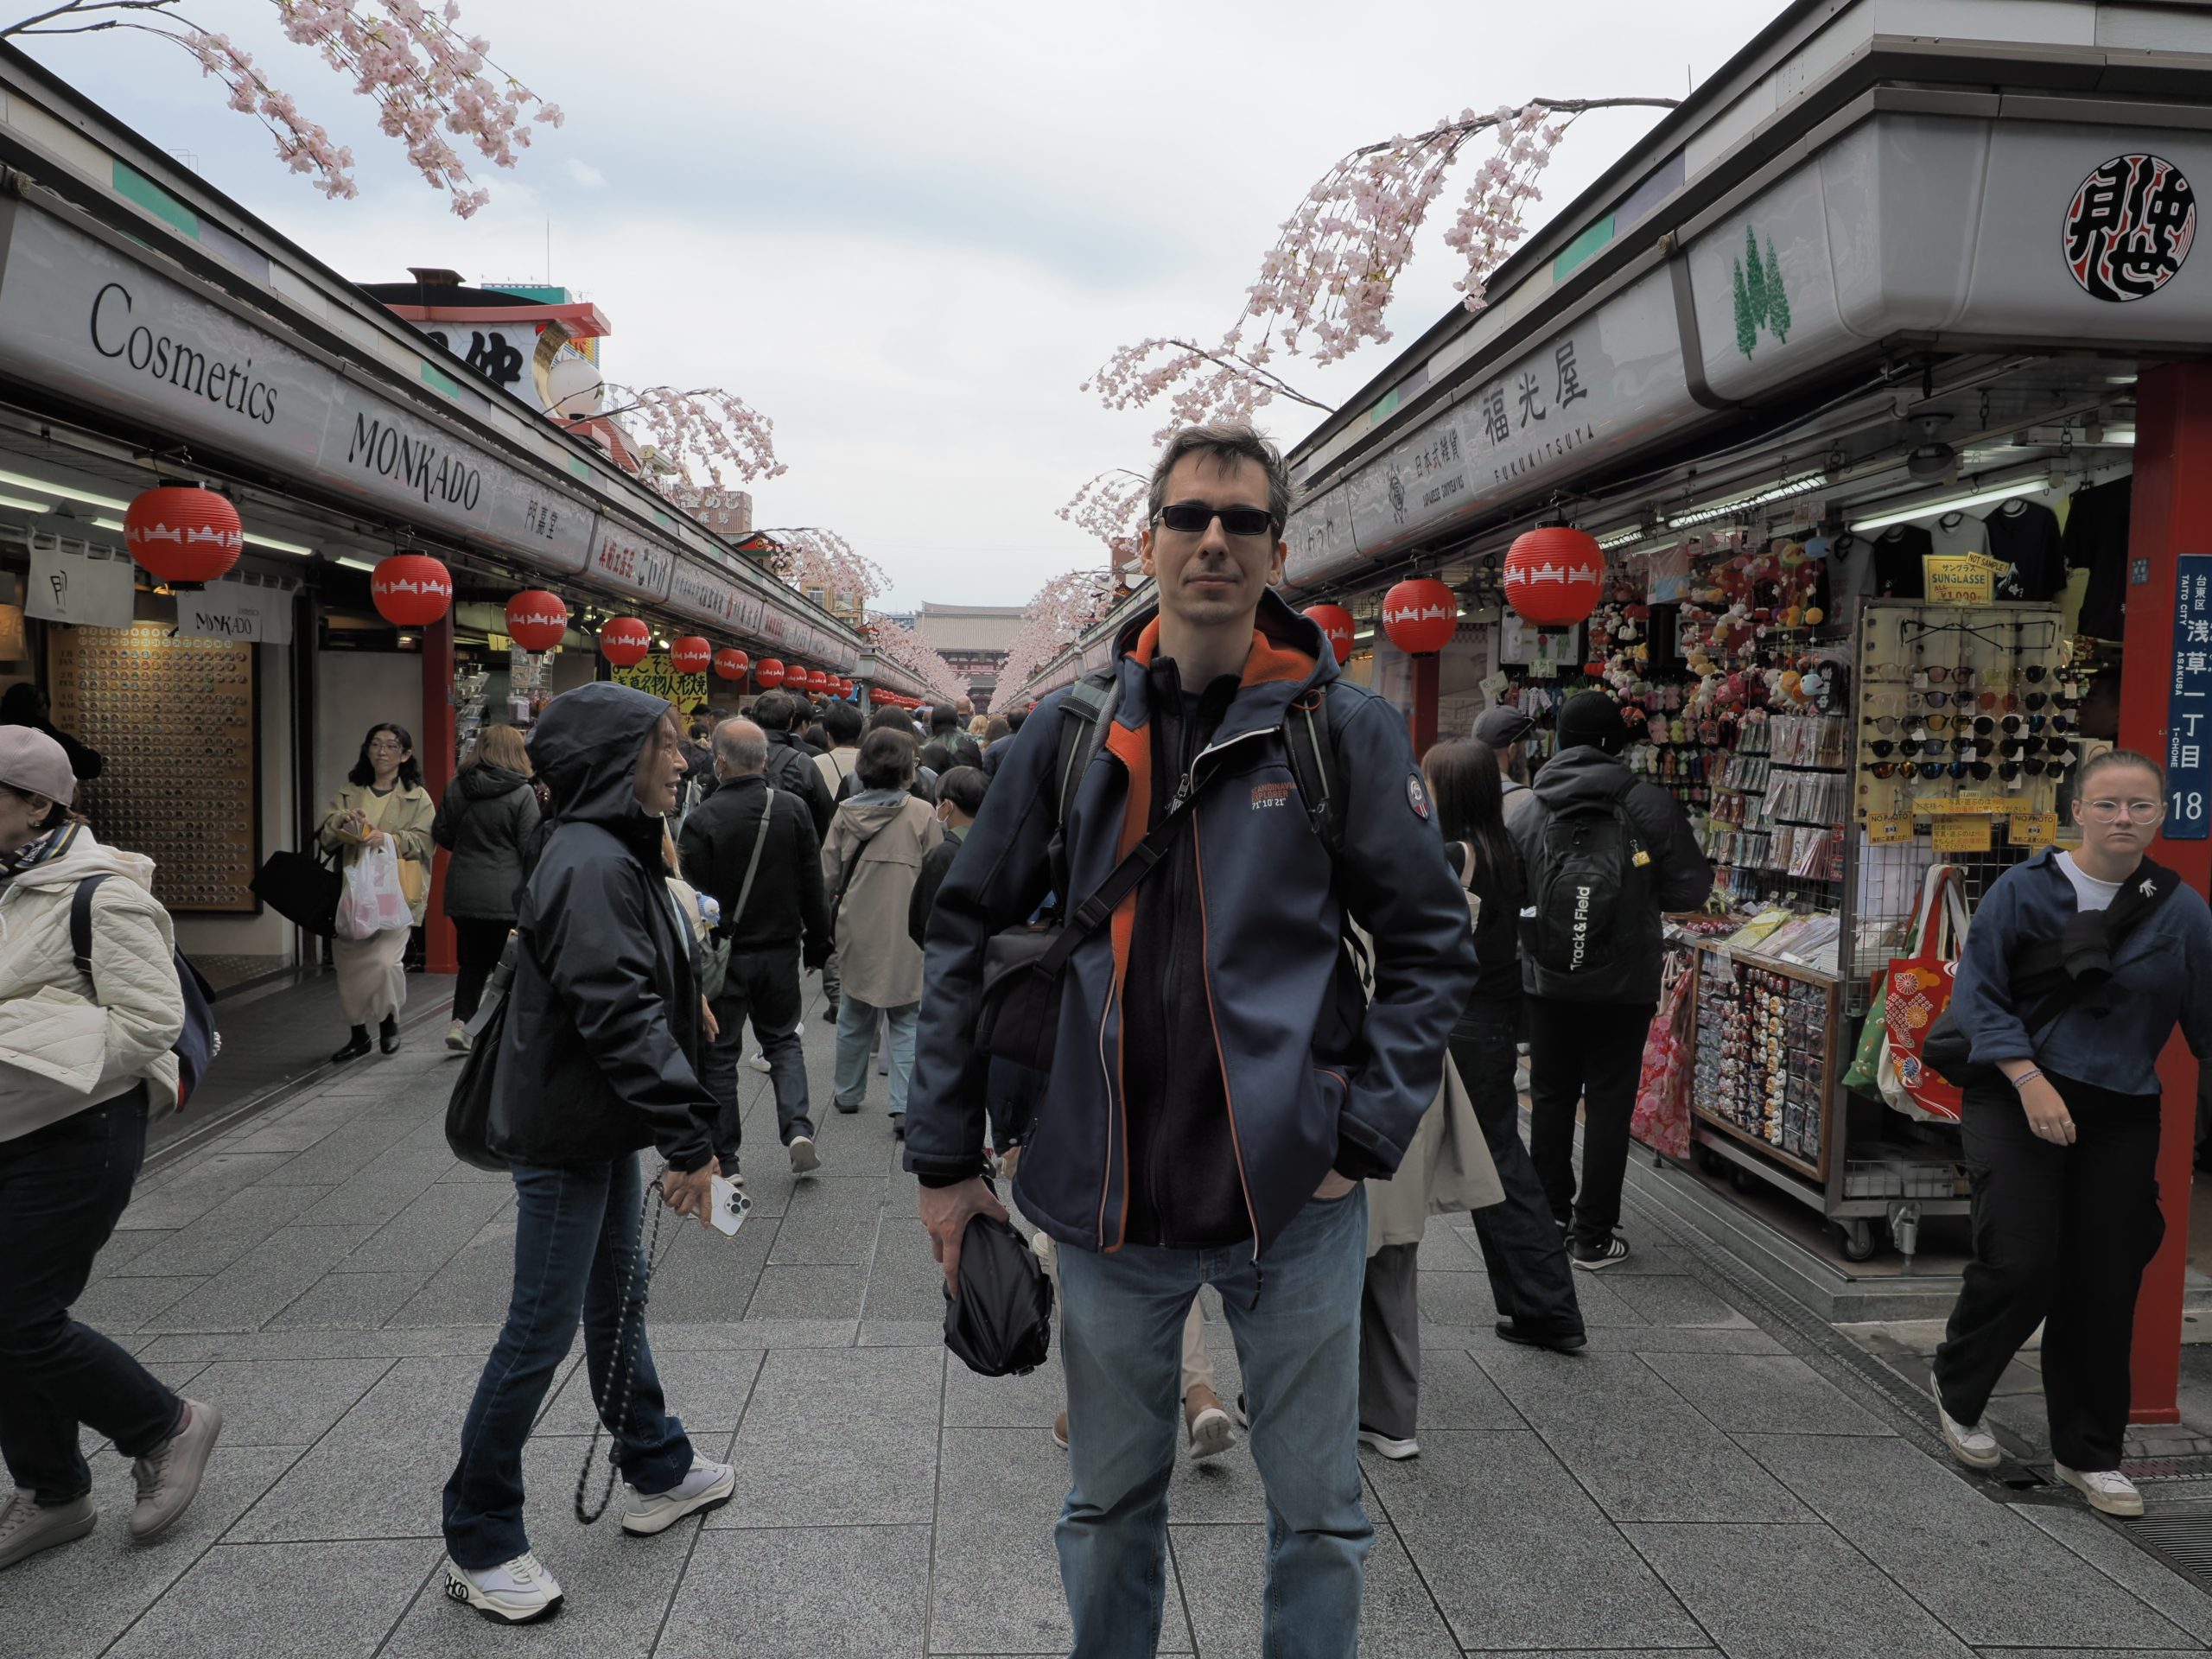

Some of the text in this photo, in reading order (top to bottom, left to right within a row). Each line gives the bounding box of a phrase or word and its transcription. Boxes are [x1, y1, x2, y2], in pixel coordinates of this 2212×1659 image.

[91, 283, 277, 424] Cosmetics
[1483, 340, 1587, 448] 福光屋
[348, 411, 480, 511] MONKADO
[1942, 563, 1976, 572] サングラス
[1968, 553, 1980, 565] NOT
[1940, 591, 1976, 601] ¥1000
[2178, 575, 2190, 626] TAITO CITY
[2194, 574, 2207, 611] 台東区
[195, 612, 252, 636] MONKADO
[2170, 652, 2185, 768] ASAKUSA 1-CHOME
[2181, 619, 2209, 768] 浅草一丁目
[1884, 813, 1909, 822] POTO
[2172, 791, 2202, 820] 18
